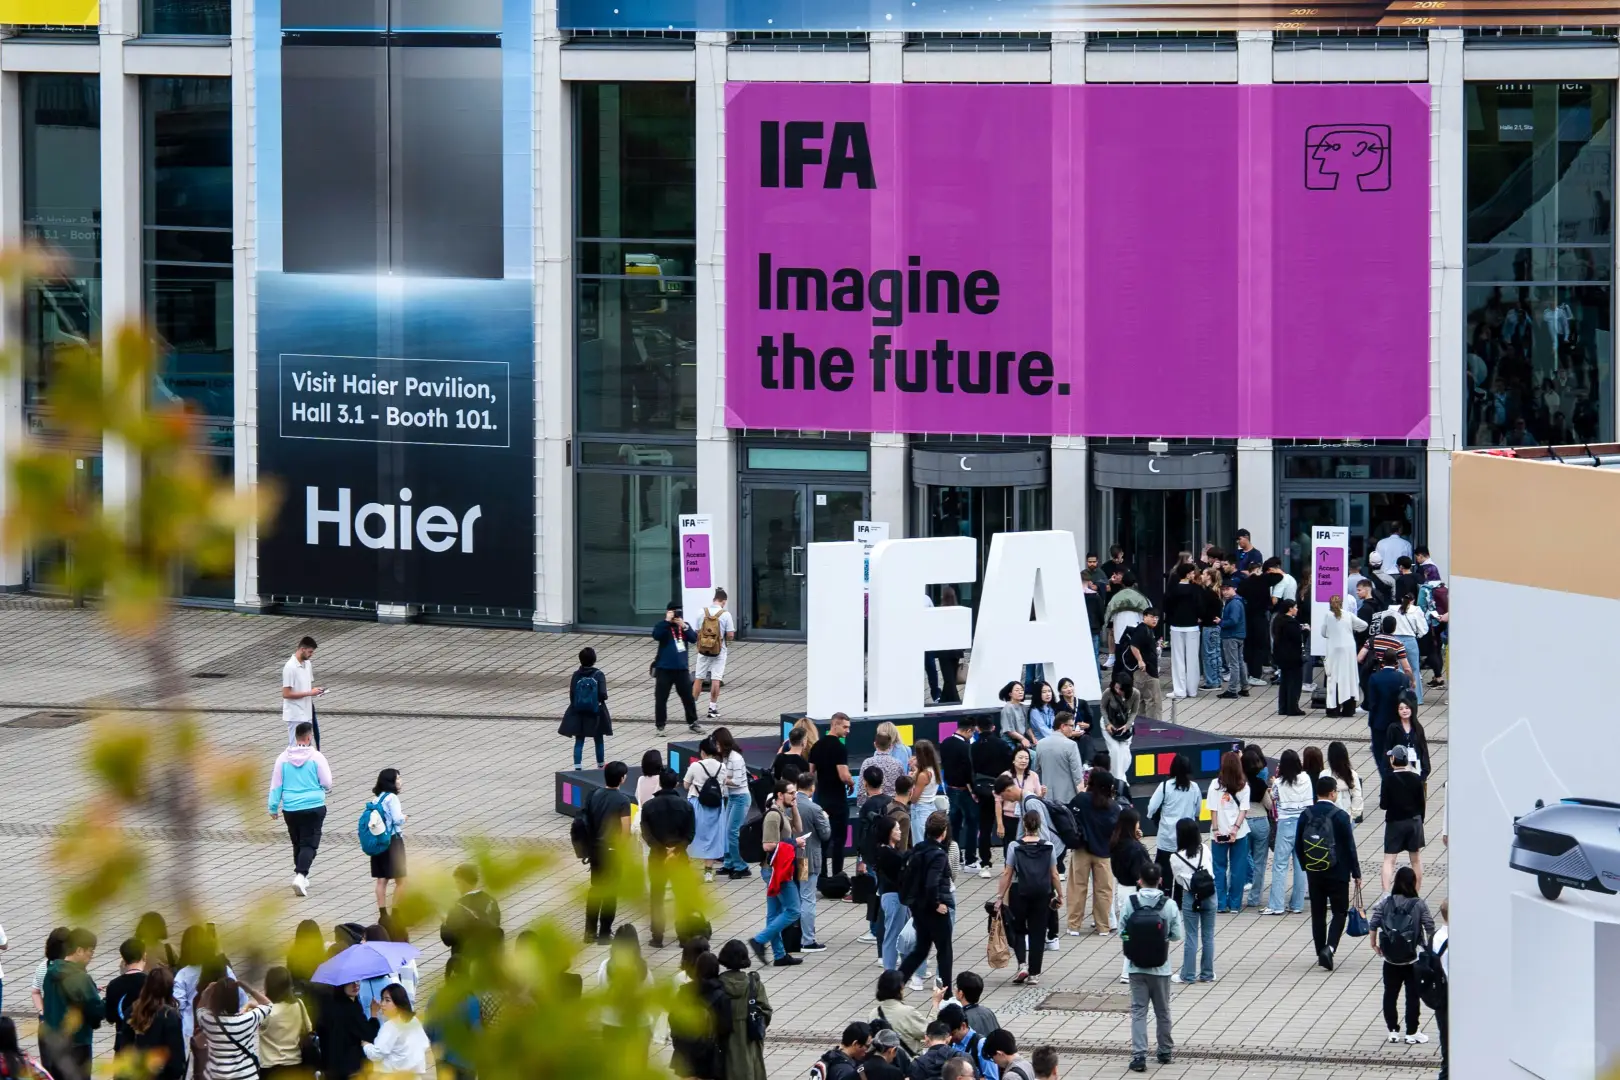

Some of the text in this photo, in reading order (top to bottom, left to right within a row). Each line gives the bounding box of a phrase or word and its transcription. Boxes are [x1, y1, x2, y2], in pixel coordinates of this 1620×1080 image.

[1289, 8, 1319, 16] 2010
[1411, 1, 1447, 9] 2016
[1402, 17, 1437, 25] 2015
[760, 120, 877, 189] IFA
[758, 252, 1000, 327] Imagine
[757, 332, 1071, 396] the future.
[291, 370, 497, 403] Visit Haier Pavilion,
[291, 402, 331, 423] Hall
[337, 403, 365, 425] 3.1
[386, 406, 448, 428] Booth
[455, 408, 498, 430] 101.
[306, 485, 482, 554] Haier
[682, 518, 696, 528] IFA
[857, 525, 870, 533] IFA
[1316, 531, 1331, 540] IFA
[807, 529, 1101, 720] IFA
